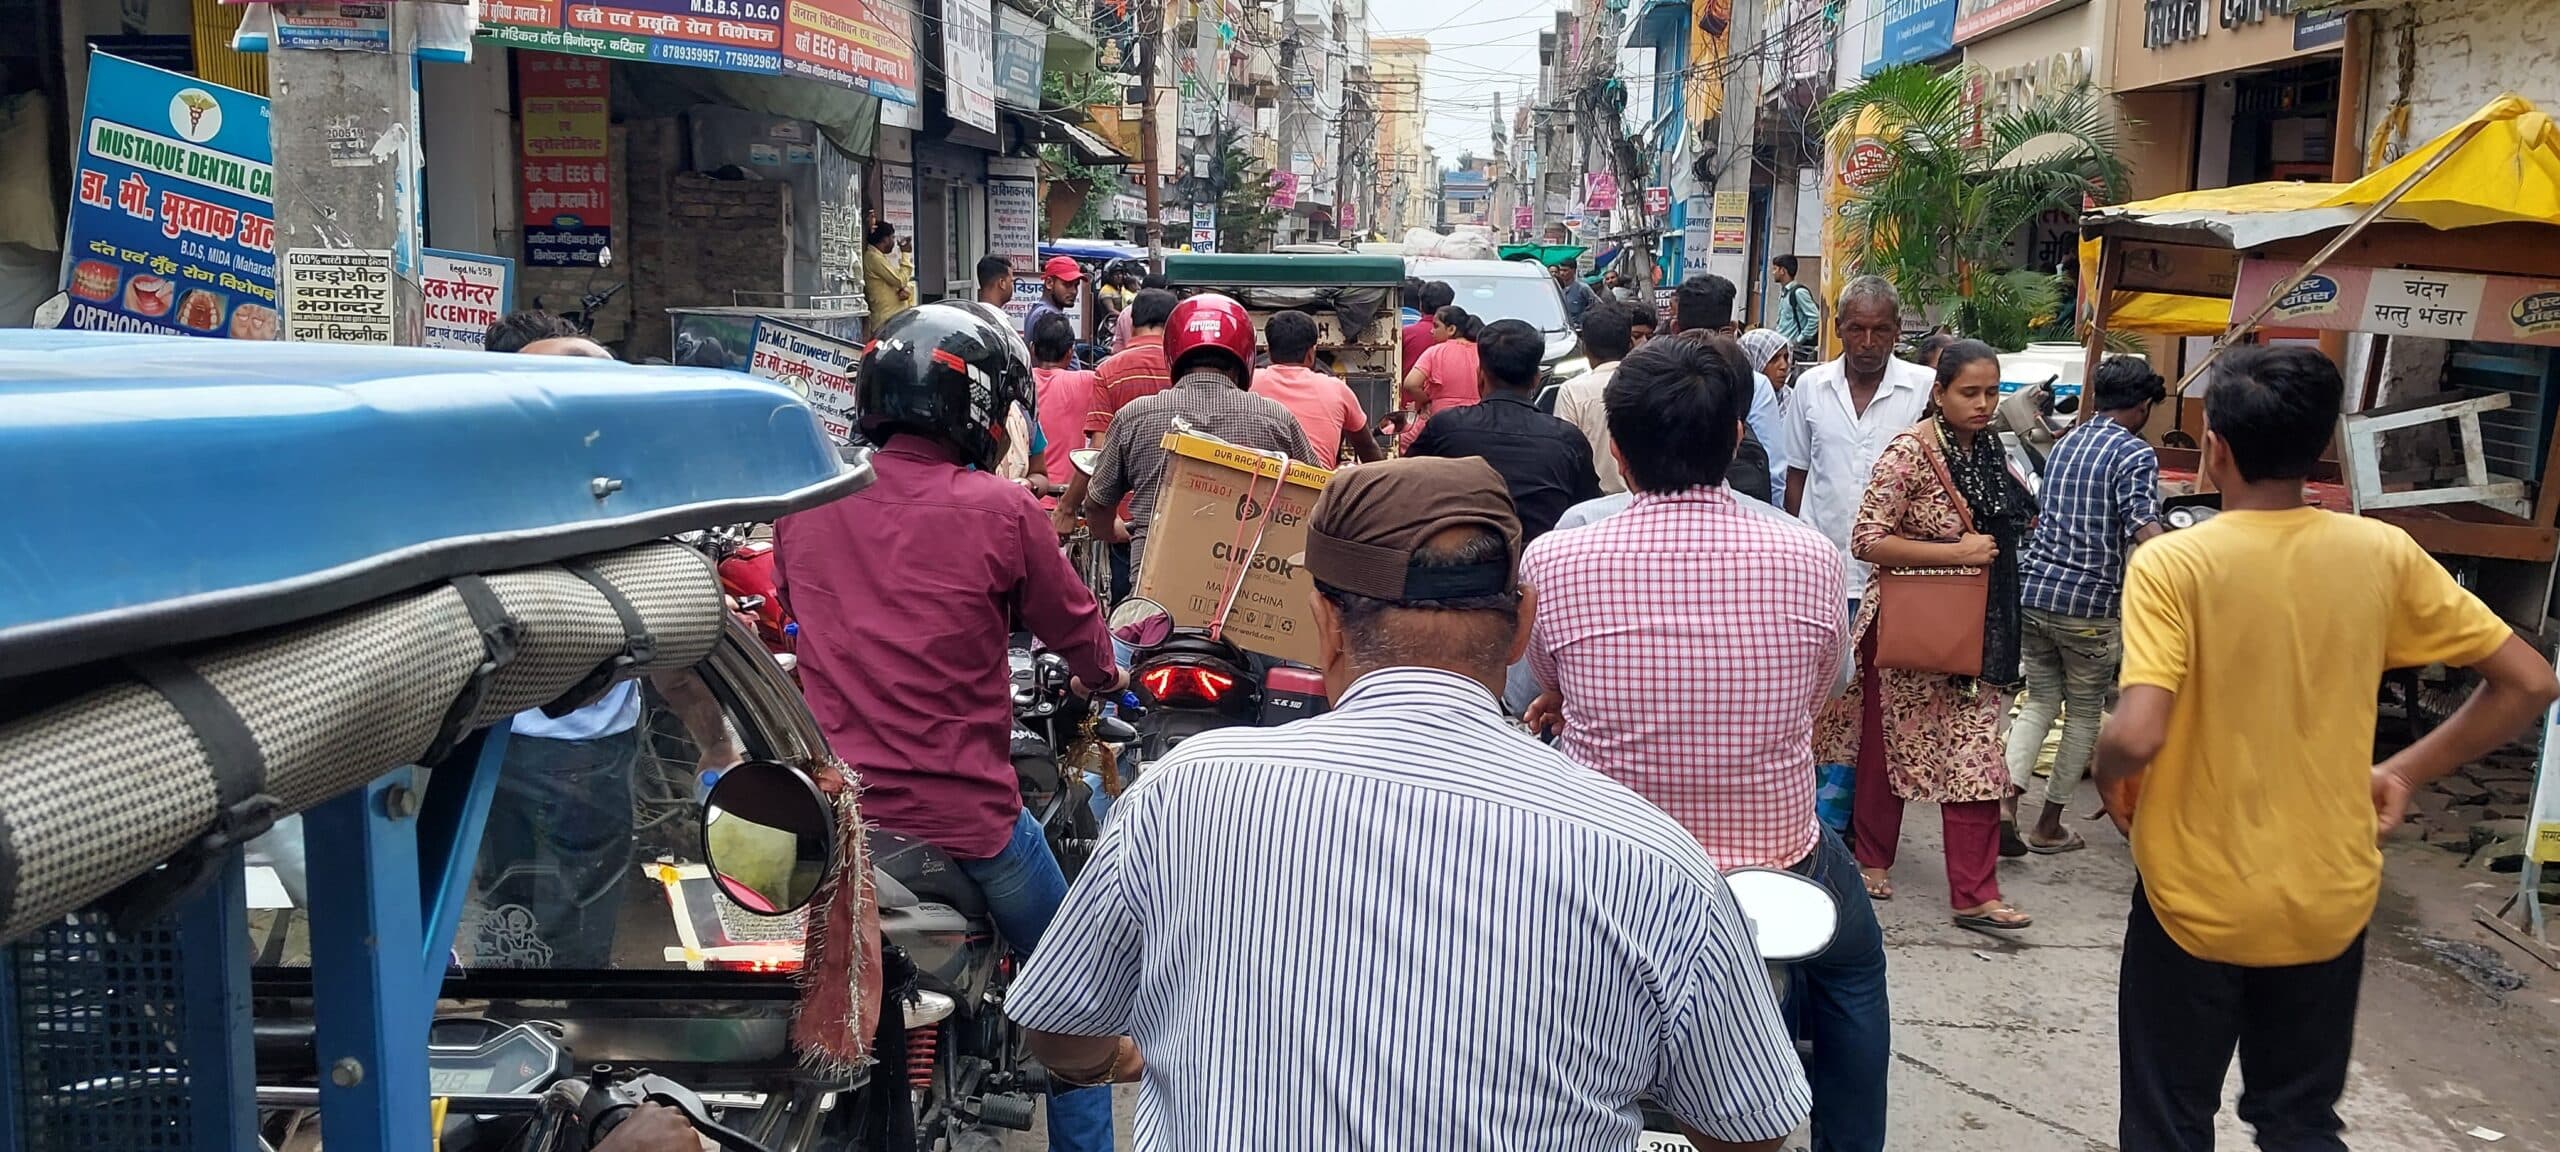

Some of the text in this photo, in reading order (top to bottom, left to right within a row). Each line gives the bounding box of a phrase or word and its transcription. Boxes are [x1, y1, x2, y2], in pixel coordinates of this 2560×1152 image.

[745, 3, 780, 20] D.G.O
[608, 11, 635, 26] एवं
[685, 18, 713, 36] रोग
[662, 45, 722, 66] 8789359957,
[813, 34, 836, 60] EEG
[97, 127, 185, 173] MUSTAQUE
[187, 151, 246, 190] DENTAL
[81, 170, 111, 208] डा.
[119, 172, 154, 219] मो.
[89, 239, 117, 257] दंत
[121, 247, 149, 265] एवं
[183, 264, 216, 284] रोग
[208, 247, 231, 268] MIDA
[291, 255, 320, 265] 100%
[450, 275, 499, 305] सेन्टर
[2404, 276, 2449, 300] चंदन
[297, 300, 385, 314] भगन्दर
[425, 303, 497, 326] IC CENTRE
[2419, 304, 2468, 326] भंडार
[1214, 449, 1233, 461] DVR
[1234, 455, 1258, 468] RACK
[1252, 592, 1285, 609] CHINA
